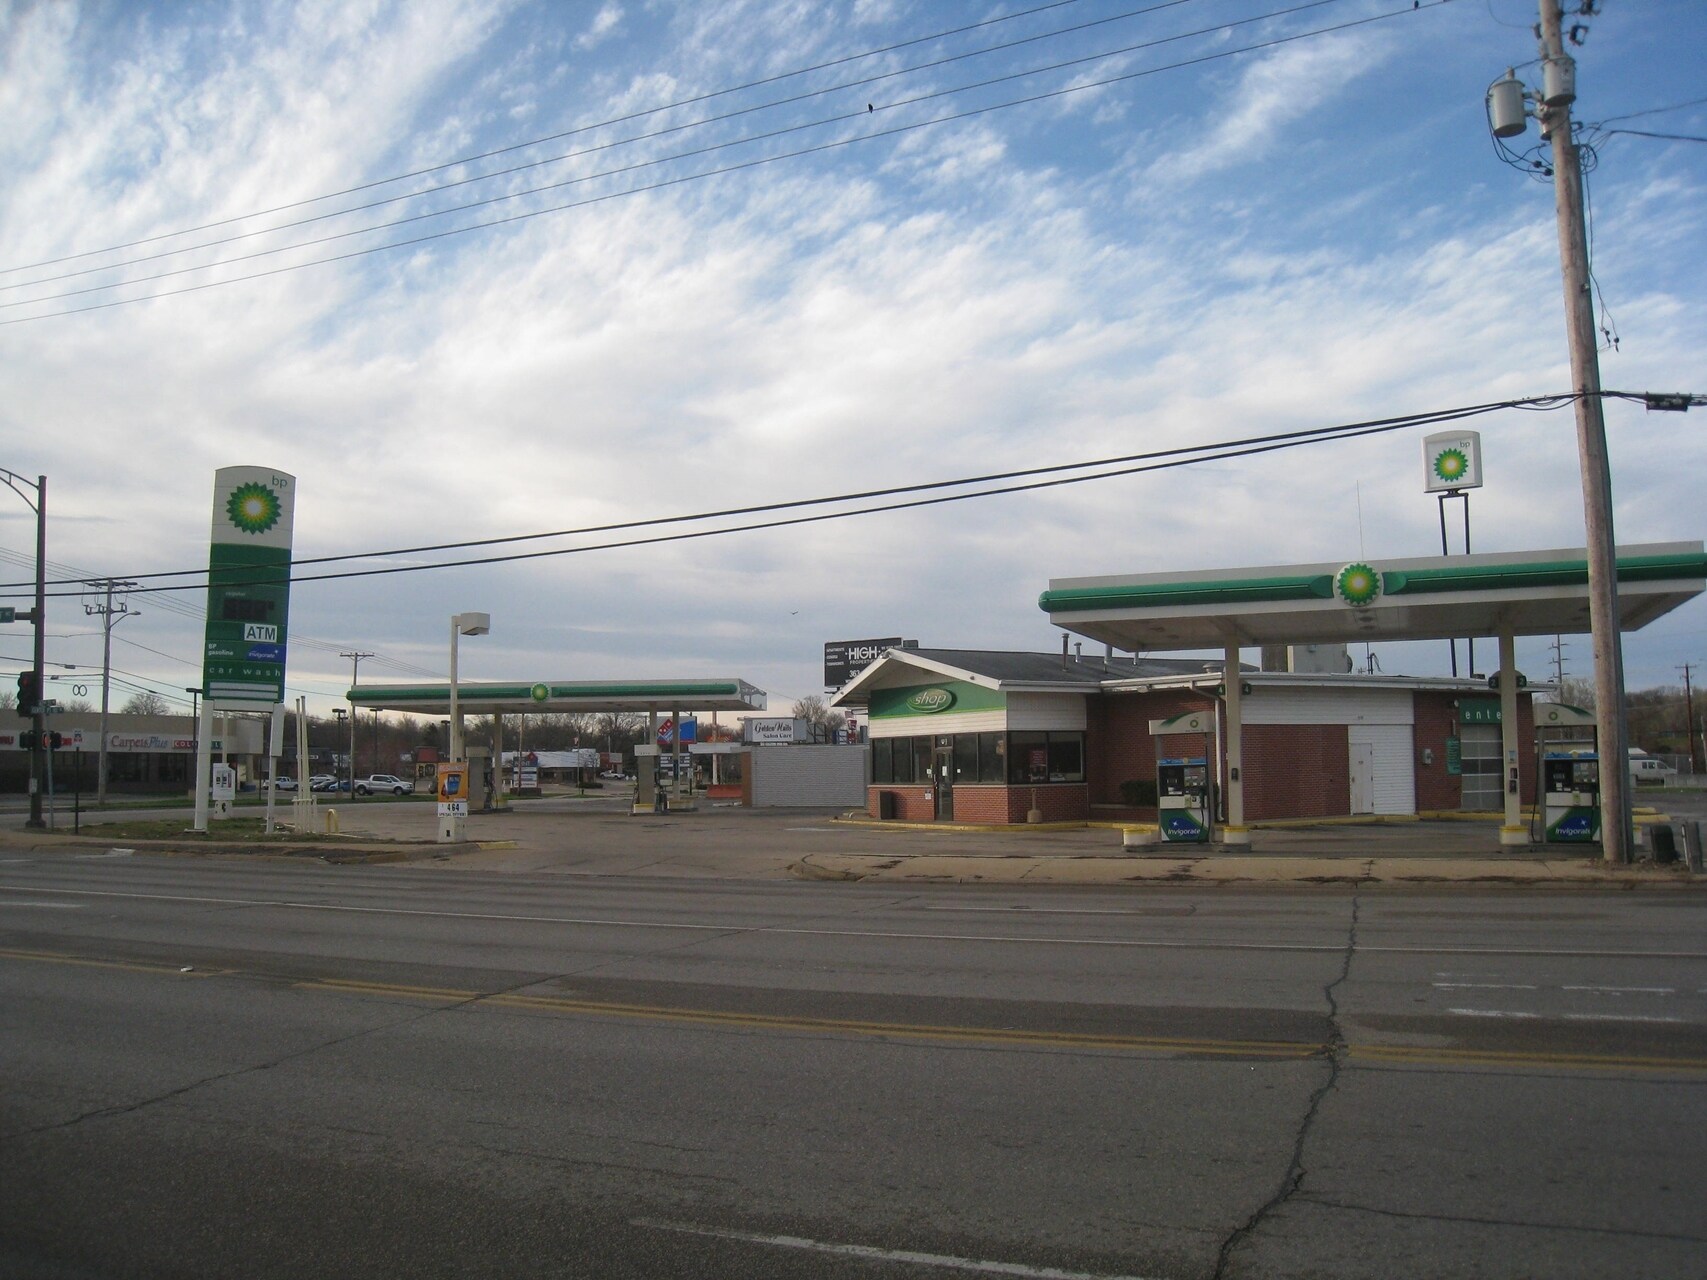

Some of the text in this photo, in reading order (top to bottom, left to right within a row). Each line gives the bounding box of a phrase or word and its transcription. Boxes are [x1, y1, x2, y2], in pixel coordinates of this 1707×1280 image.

[1459, 441, 1471, 449] bp
[271, 475, 288, 488] bp
[246, 626, 276, 640] ATM
[848, 646, 878, 660] HIGH
[243, 669, 281, 677] wash
[915, 691, 947, 708] shop
[1465, 708, 1501, 720] ente
[754, 722, 792, 734] Golden Nails
